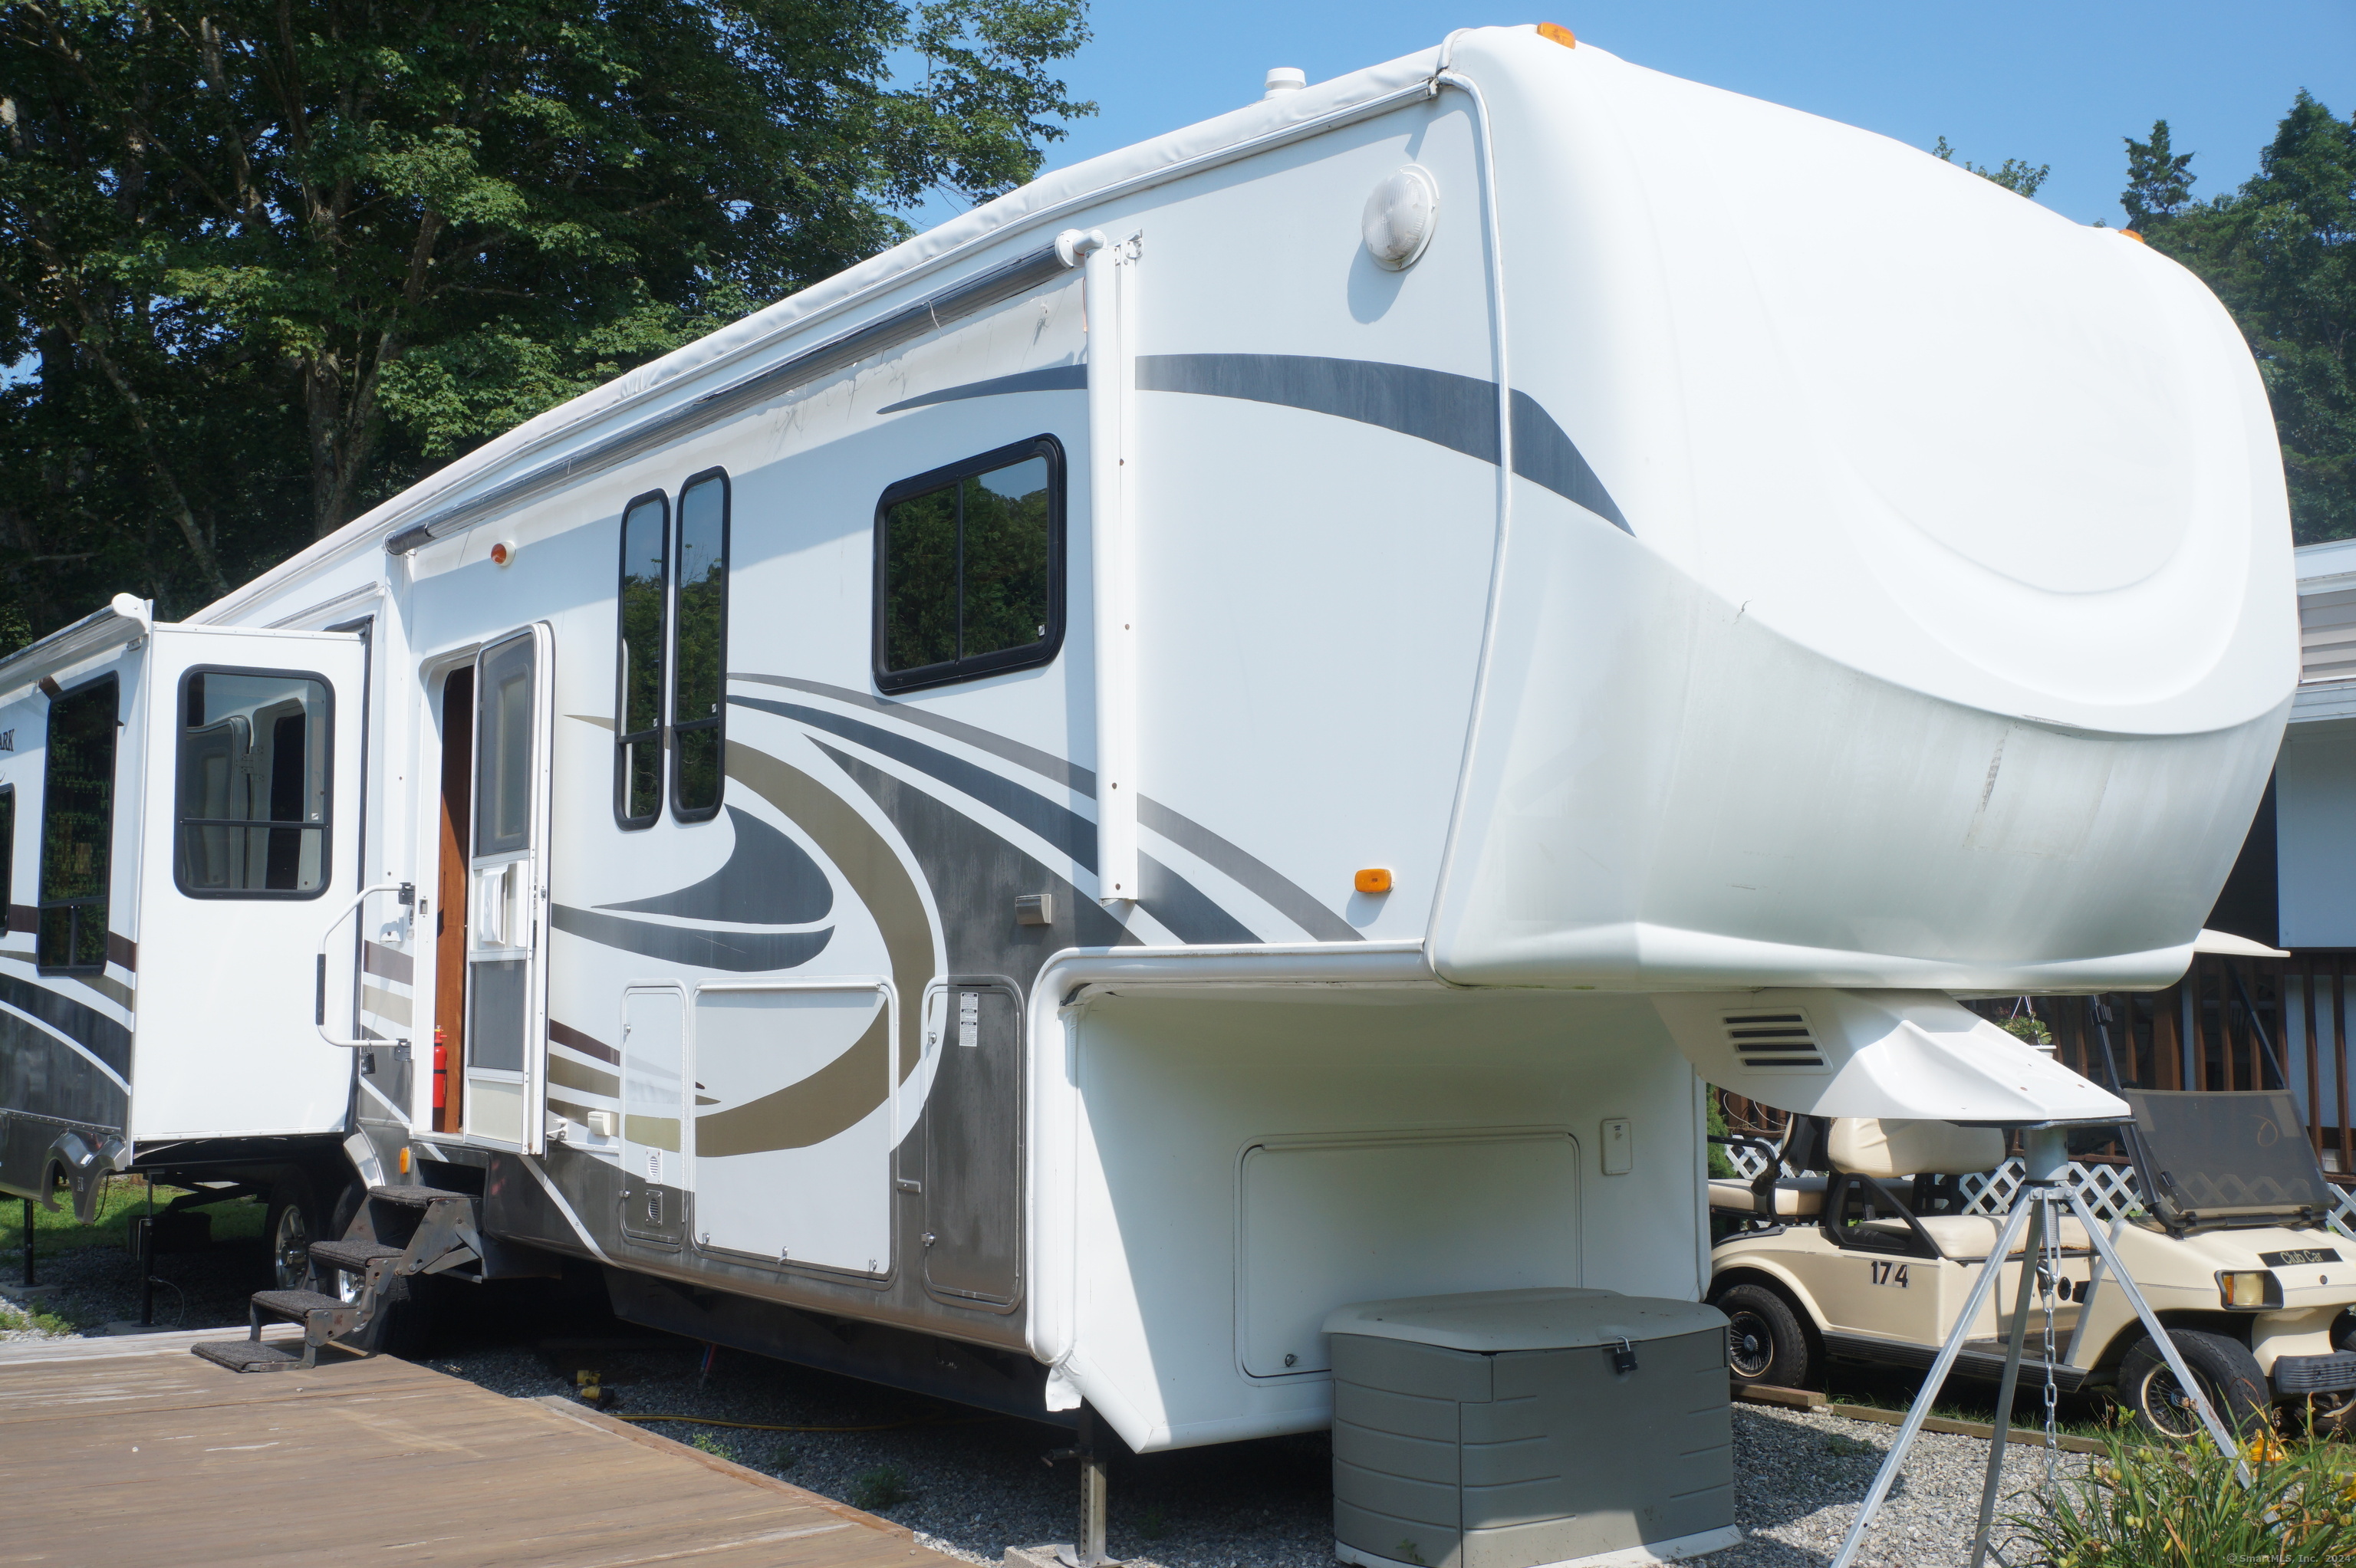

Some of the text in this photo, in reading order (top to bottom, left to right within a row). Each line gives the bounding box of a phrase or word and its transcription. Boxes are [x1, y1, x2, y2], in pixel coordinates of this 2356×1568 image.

[2279, 1250, 2324, 1264] Club Car
[1871, 1261, 1908, 1288] 174
